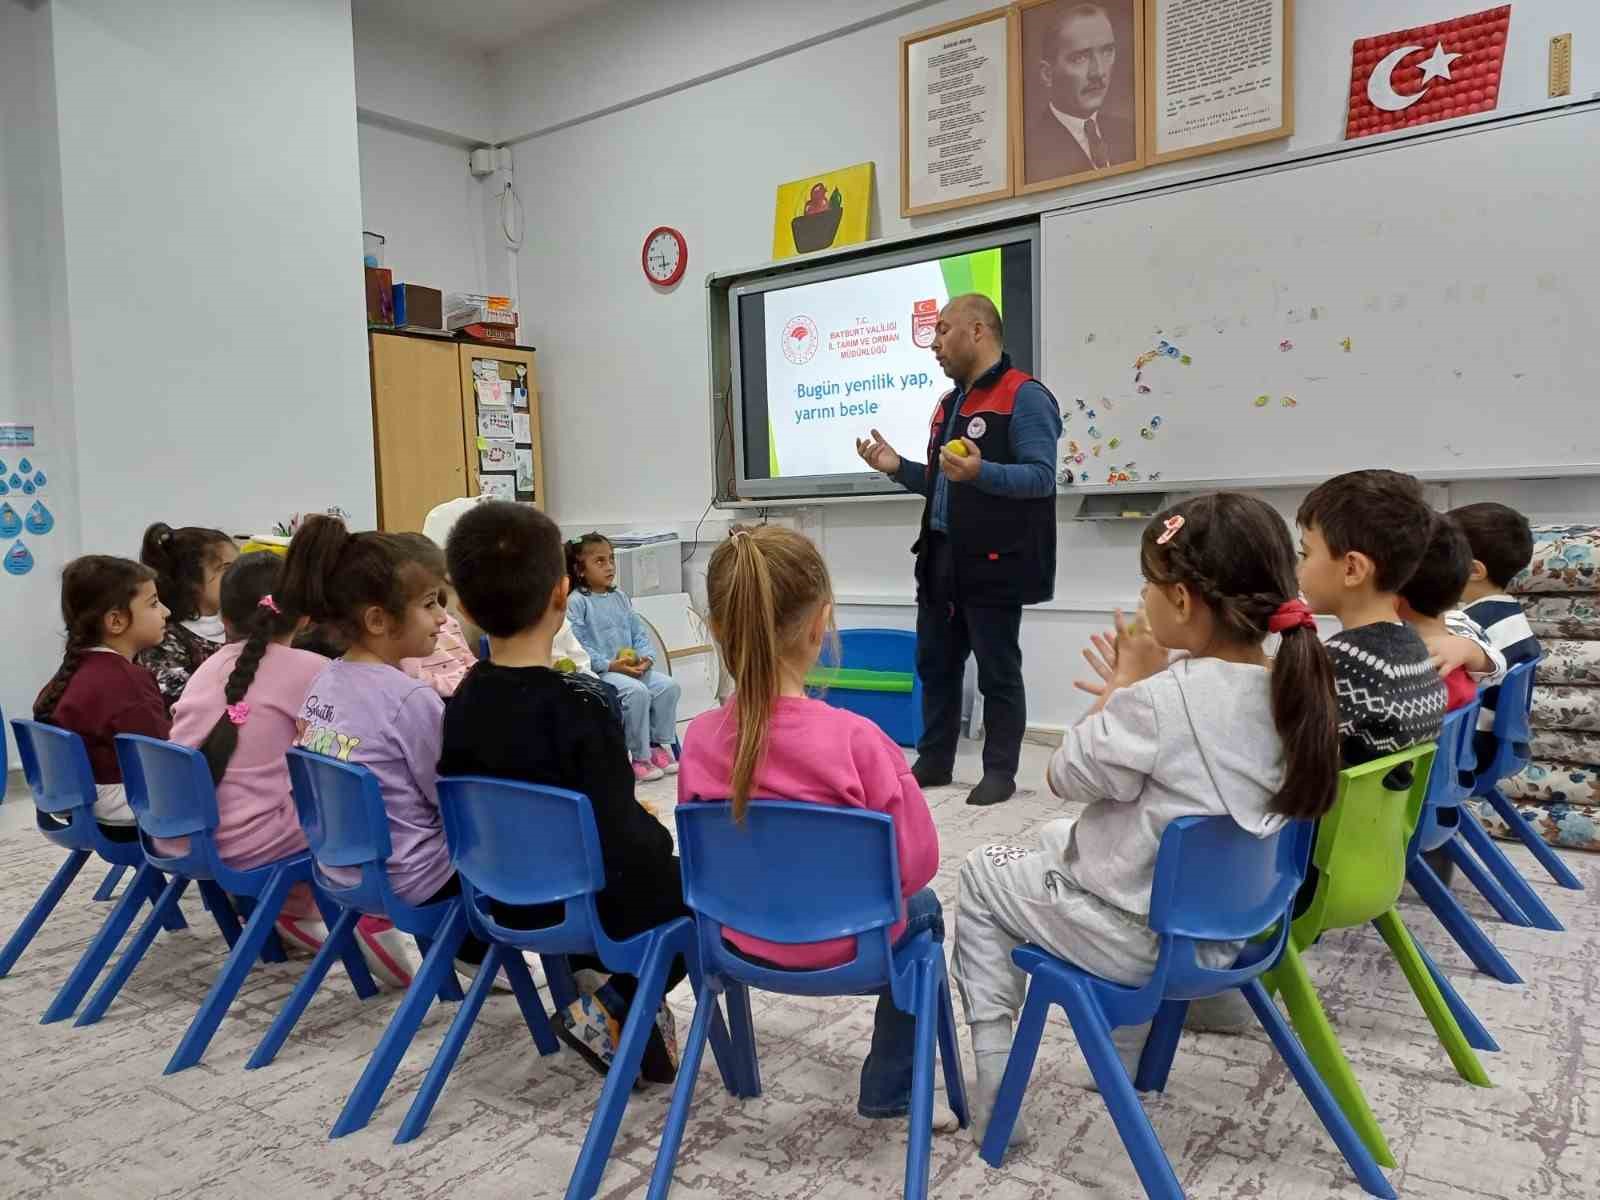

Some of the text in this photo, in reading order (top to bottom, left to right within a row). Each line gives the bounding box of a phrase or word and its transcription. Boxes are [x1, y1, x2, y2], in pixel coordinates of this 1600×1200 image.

[860, 337, 871, 346] VE
[871, 333, 900, 345] ORMAN
[797, 372, 934, 400] Bugün yenilik yap,
[794, 400, 879, 425] yarını besle
